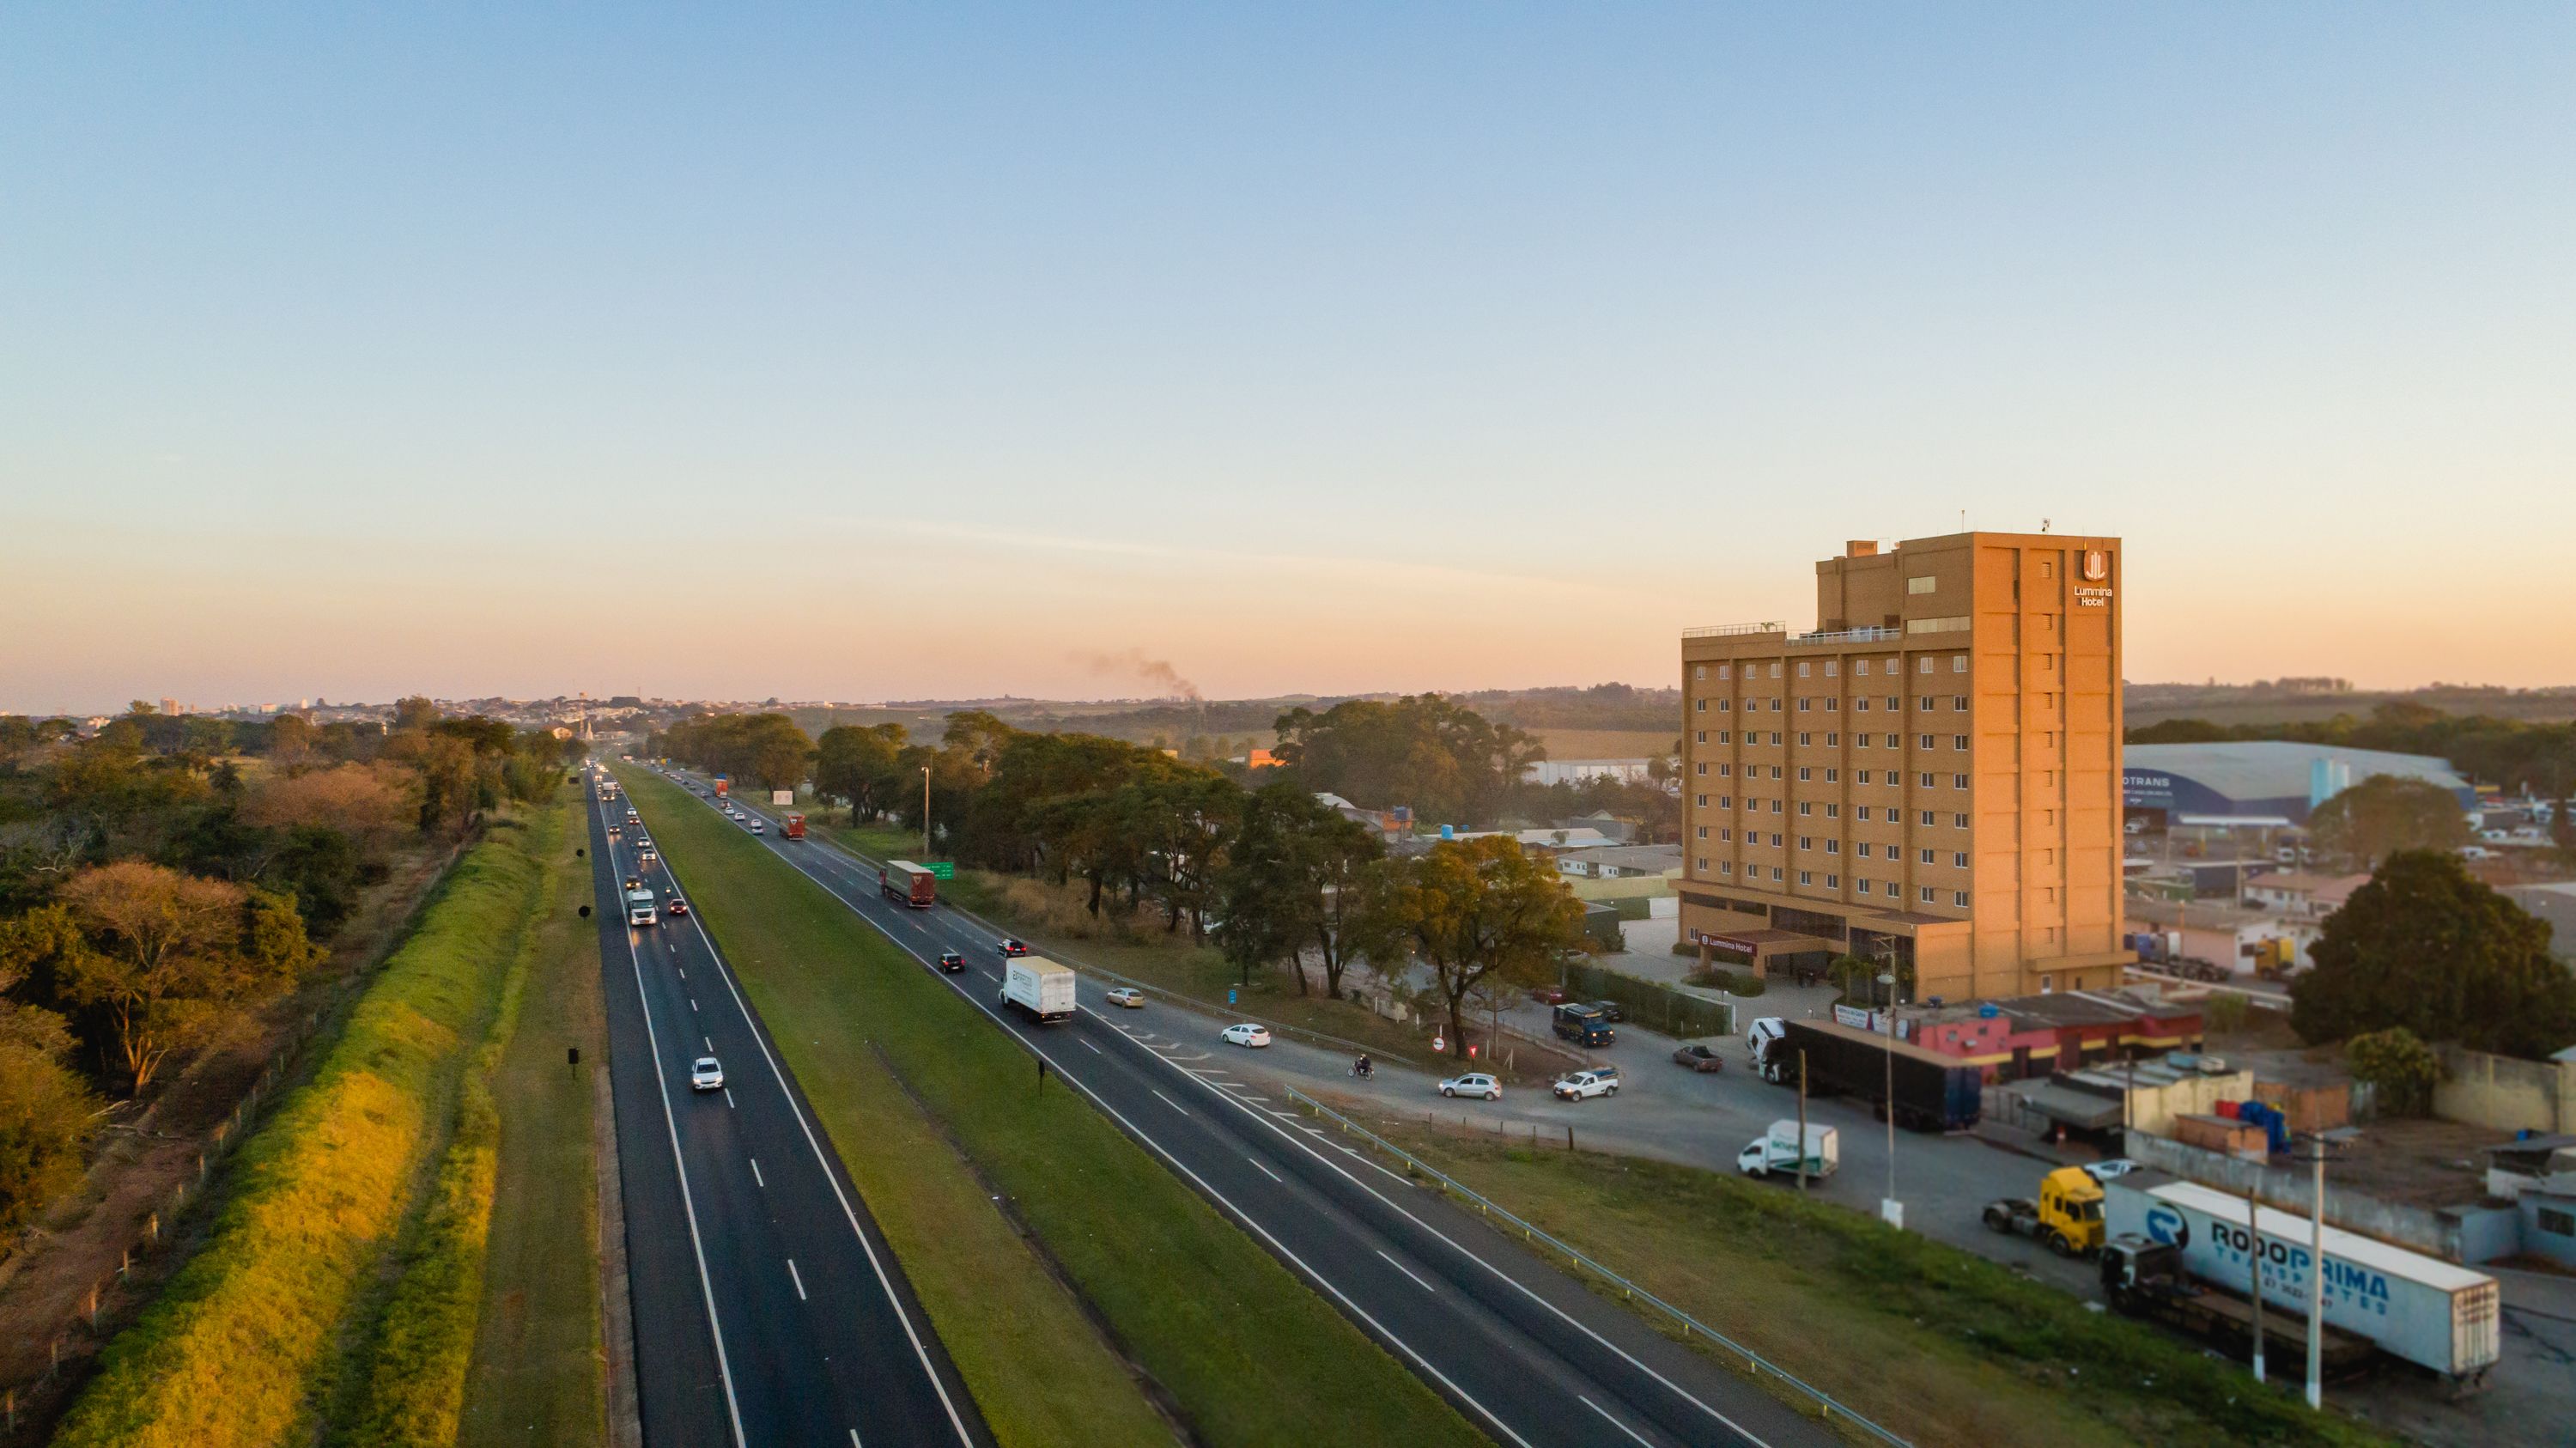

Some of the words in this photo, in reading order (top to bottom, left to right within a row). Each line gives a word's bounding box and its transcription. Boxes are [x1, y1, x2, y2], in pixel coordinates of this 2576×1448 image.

[2074, 585, 2112, 597] Lummina
[2081, 597, 2104, 606] Hotel
[1710, 937, 1735, 950] Lummina
[1735, 943, 1753, 953] Hotel
[2213, 1245, 2387, 1317] TRANSPRTES
